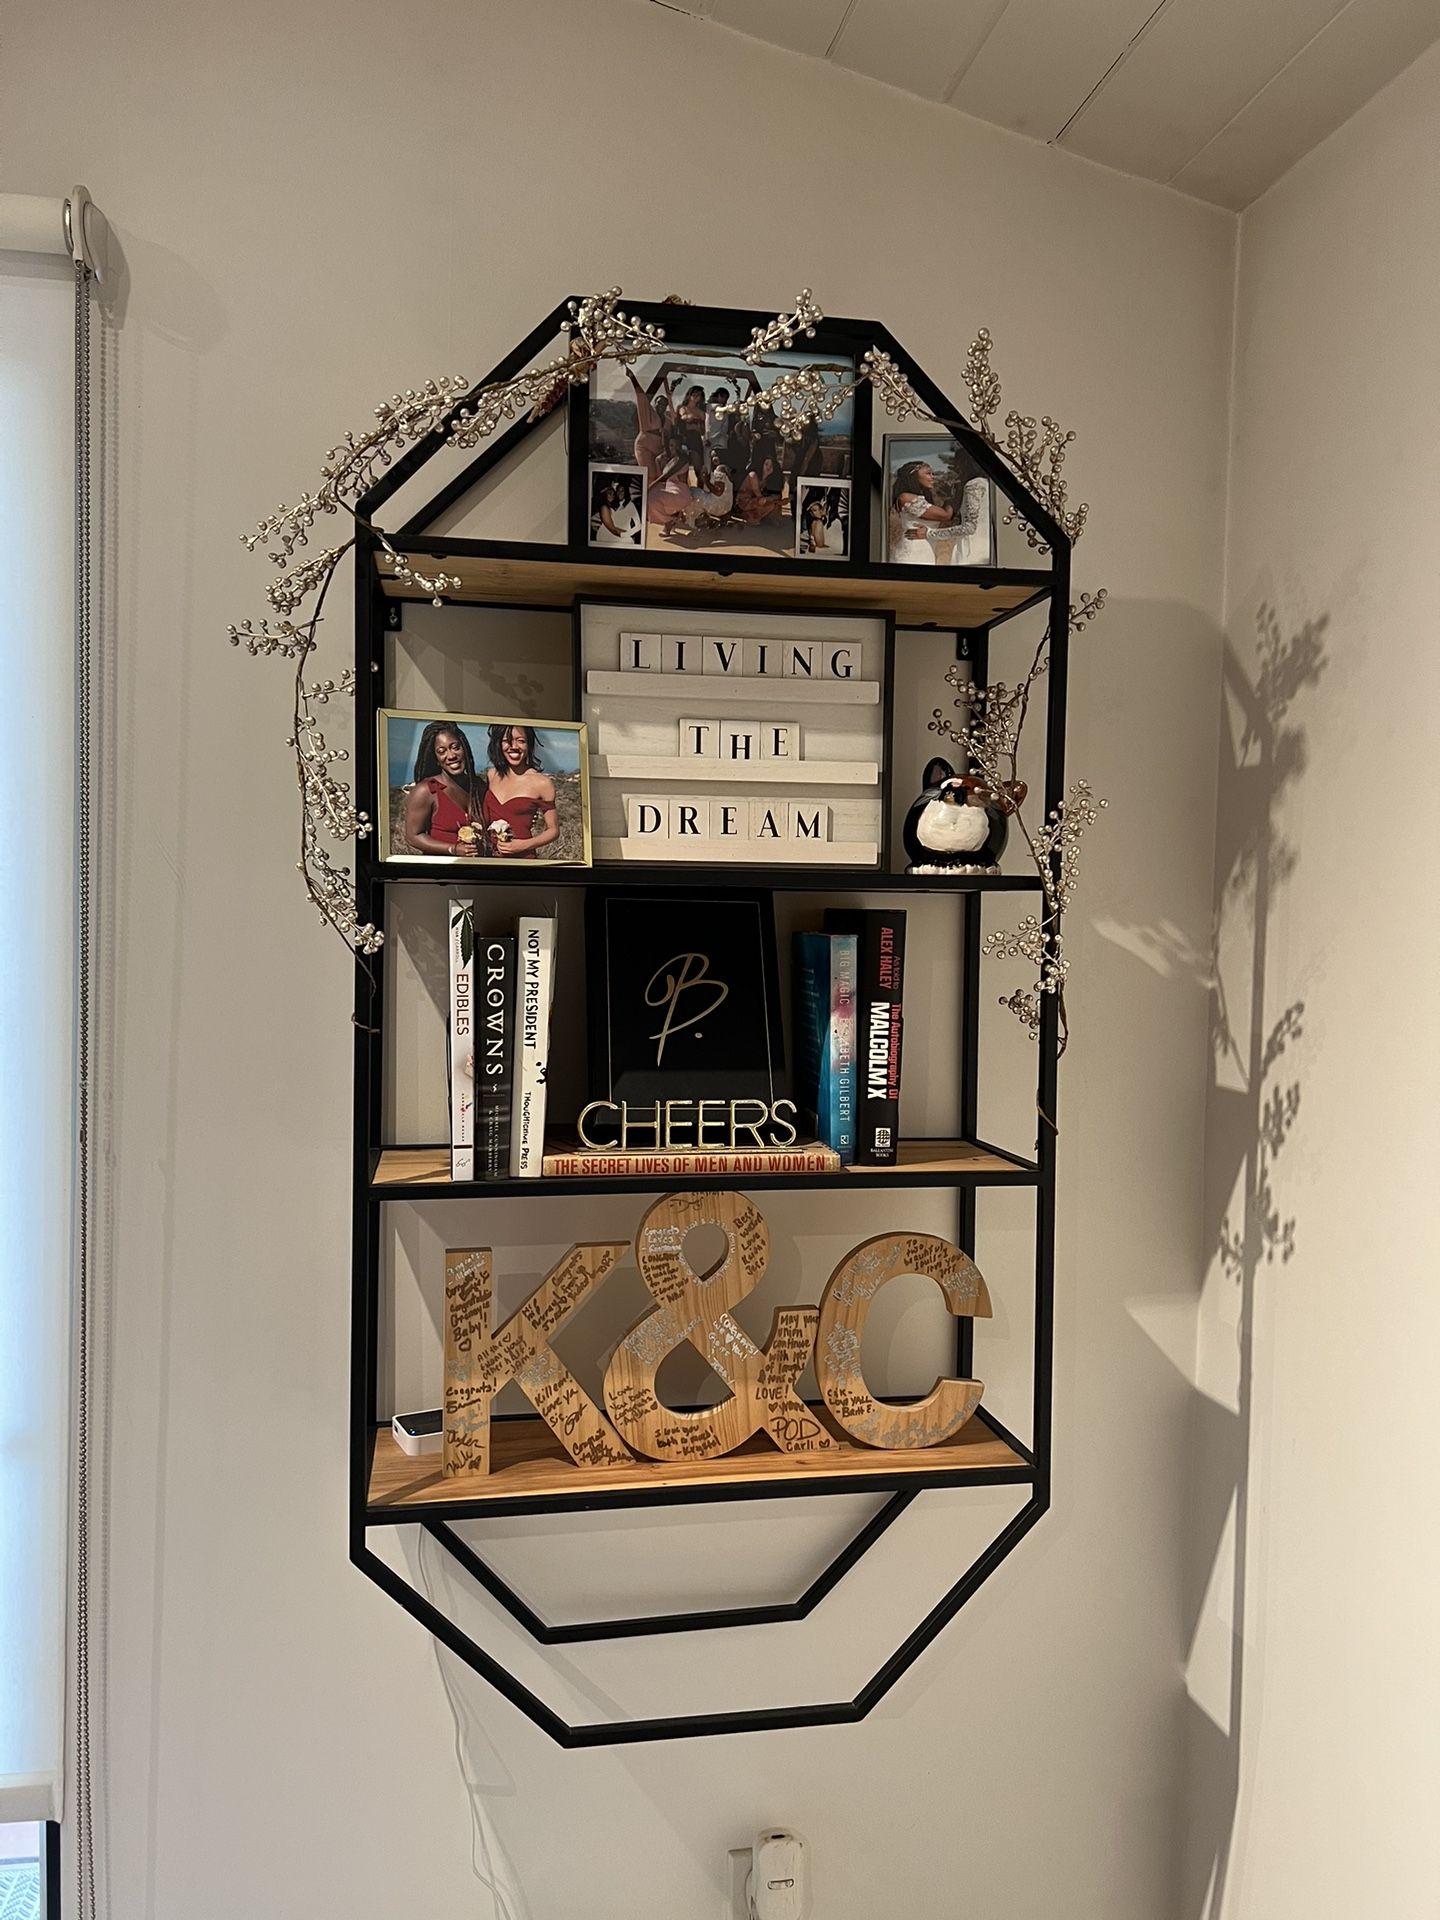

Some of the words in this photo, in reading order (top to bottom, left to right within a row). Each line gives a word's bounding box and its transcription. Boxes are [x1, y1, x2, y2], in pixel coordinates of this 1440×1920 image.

[632, 639, 853, 679] LIVING
[688, 725, 788, 760] THE
[637, 804, 821, 839] DREAM
[528, 929, 540, 957] NOT
[880, 927, 894, 953] ALEX
[526, 959, 541, 978] MY
[840, 950, 850, 967] BIG
[893, 955, 901, 966] As
[879, 956, 893, 989] HALEY
[893, 967, 901, 981] told
[840, 971, 850, 1005] MAGIC
[456, 973, 469, 1036] EDIBLES
[486, 943, 505, 1076] CROWNS
[524, 981, 540, 1049] PRESIDENT
[891, 1003, 901, 1020] The
[868, 1002, 890, 1086] MALCOLM
[888, 1021, 901, 1086] Autobiography
[840, 1078, 850, 1122] GILBERT
[867, 1087, 887, 1099] X
[577, 1099, 797, 1150] CHEERS
[520, 1147, 530, 1170] PRESS
[554, 1159, 578, 1175] THE
[581, 1157, 632, 1175] SECRET
[635, 1156, 670, 1174] LIVES
[673, 1156, 690, 1173] OF
[695, 1155, 727, 1173] MEN
[733, 1154, 762, 1172] AND
[768, 1153, 826, 1172] WOMEN
[733, 1206, 755, 1229] Best
[741, 1232, 761, 1251] Love
[780, 1314, 800, 1327] May
[720, 1312, 759, 1358] CONGRATS!
[772, 1339, 811, 1349] continue
[778, 1327, 803, 1338] union
[477, 1350, 490, 1363] All
[769, 1350, 789, 1362] with
[446, 1377, 497, 1401] Congrats!
[755, 1384, 789, 1400] LOVE!
[542, 1397, 563, 1417] Love
[682, 1424, 700, 1437] you
[769, 1416, 821, 1441] POD
